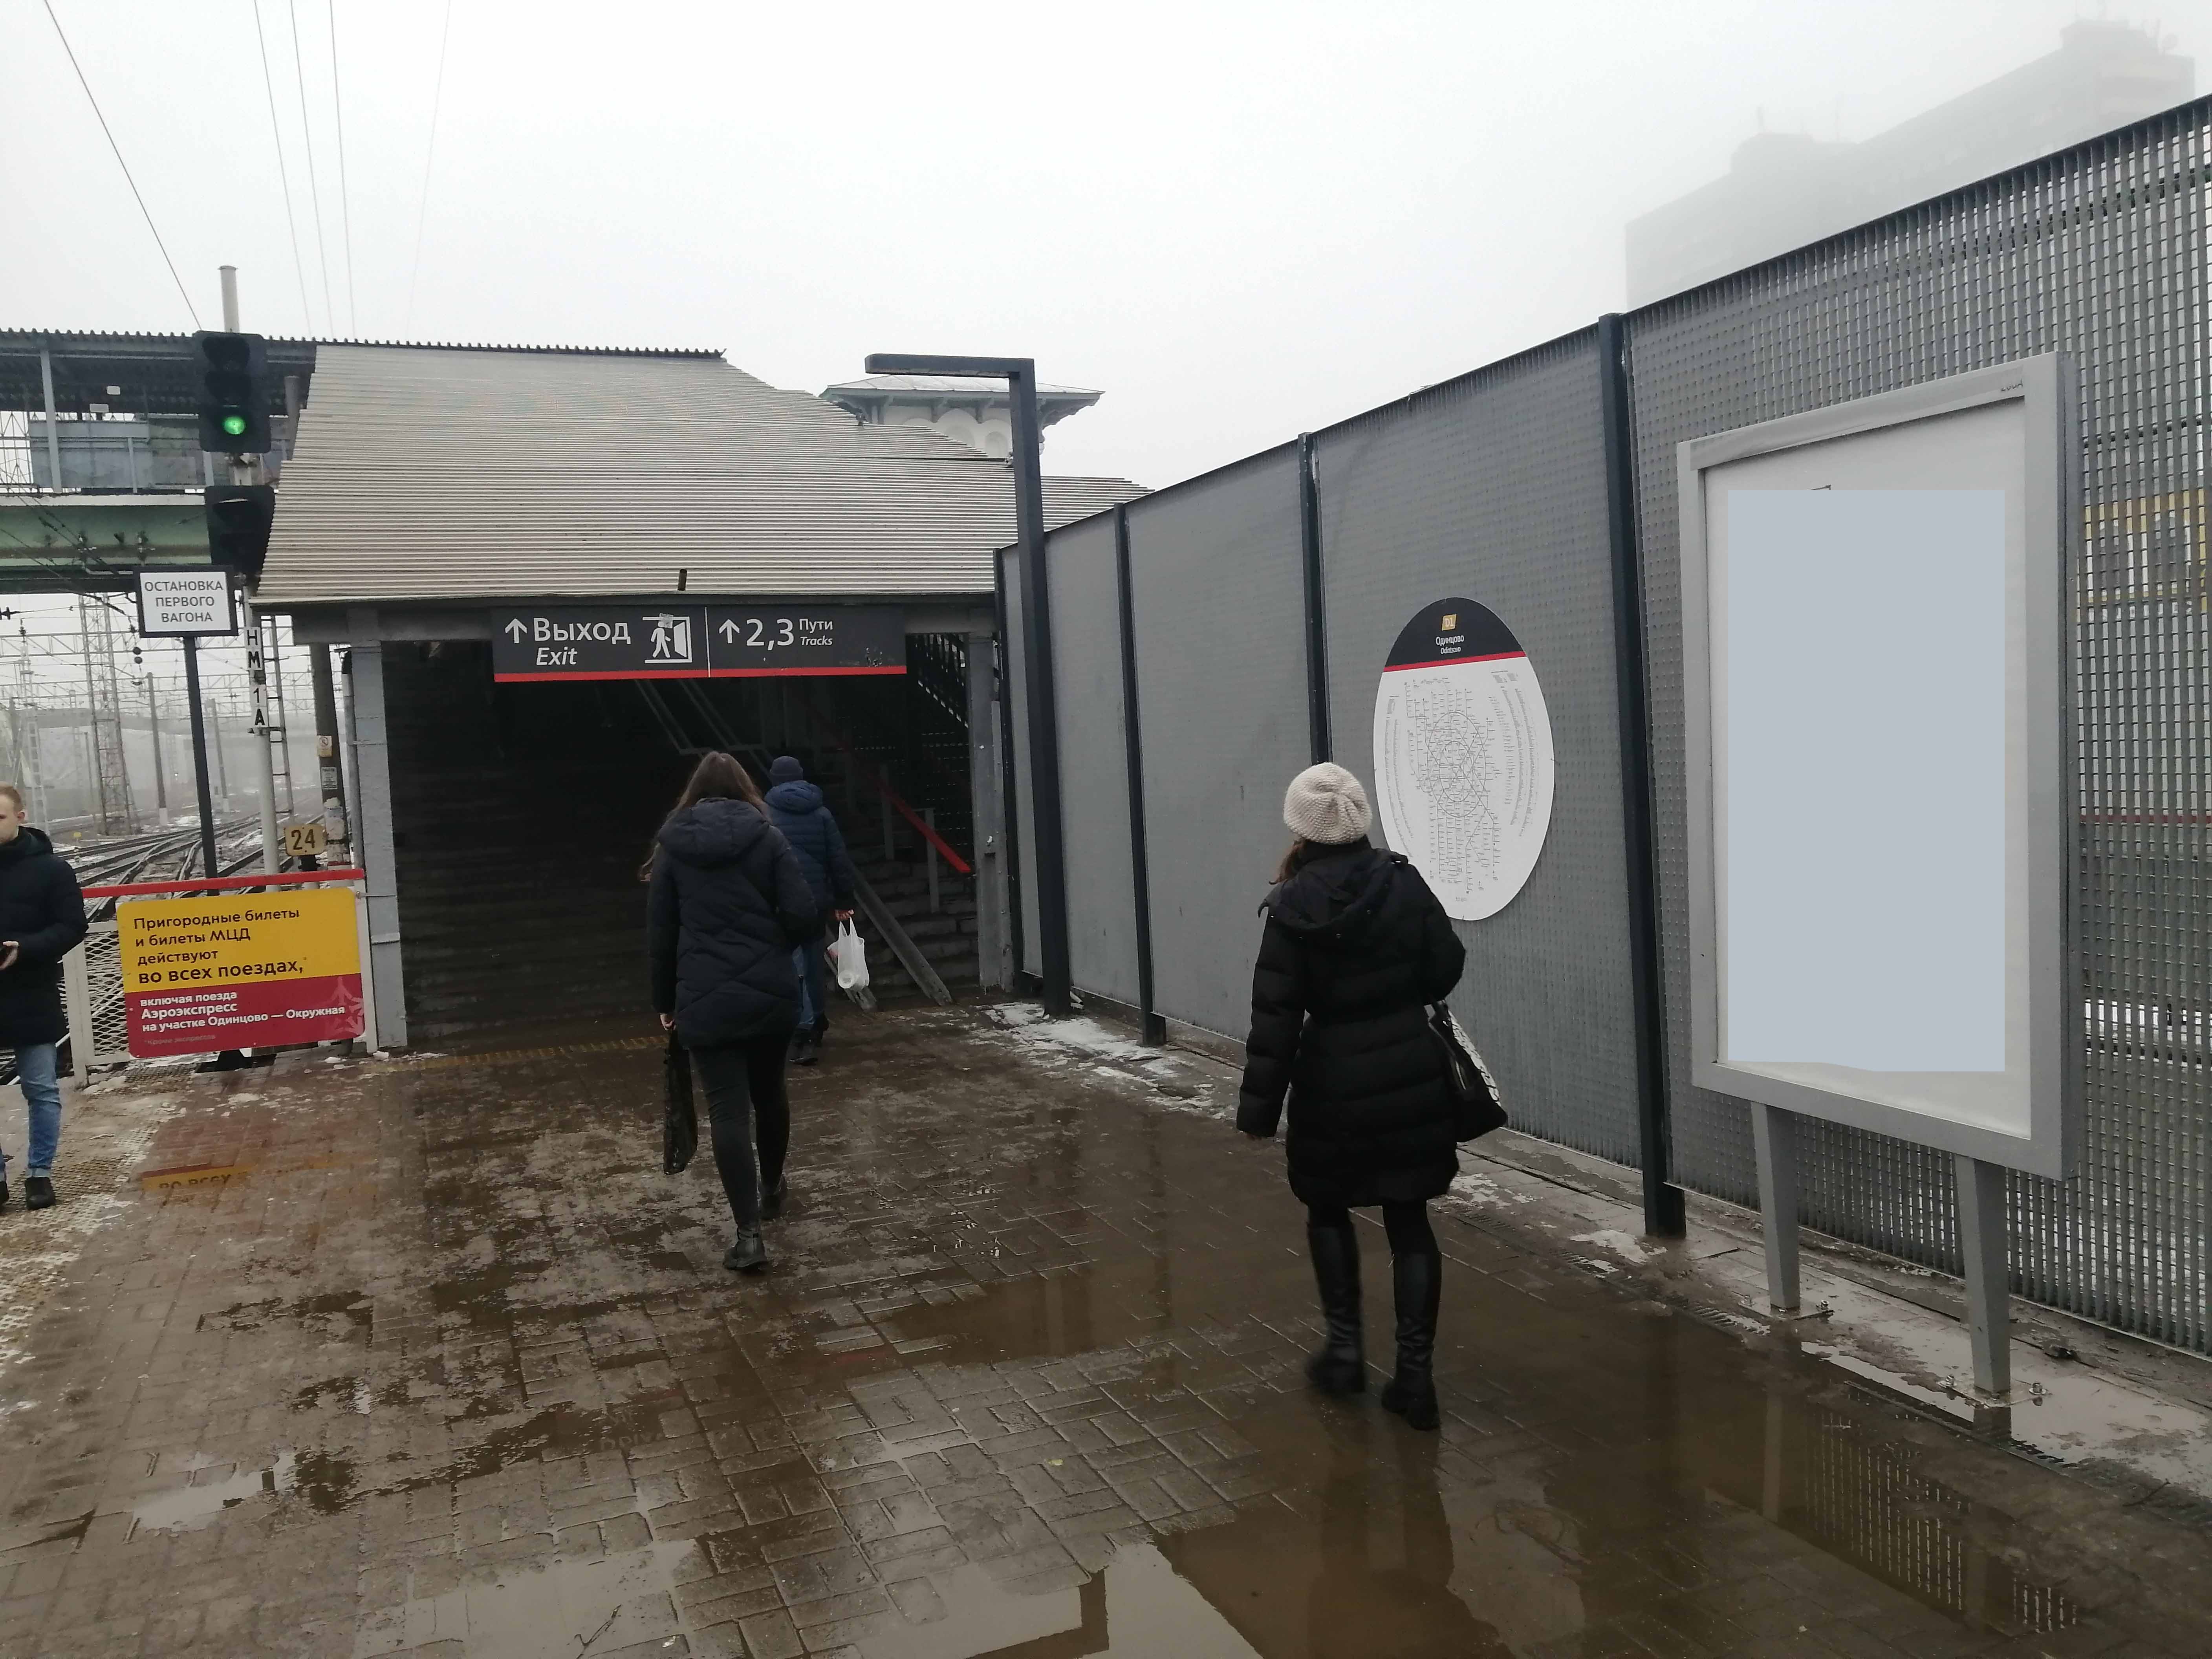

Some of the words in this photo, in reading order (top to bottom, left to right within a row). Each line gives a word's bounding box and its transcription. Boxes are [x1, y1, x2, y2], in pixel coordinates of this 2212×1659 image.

[145, 581, 223, 591] ОСТАНОВКА
[156, 596, 215, 607] ПЕРВОГО
[161, 612, 213, 623] ВАГОНА
[1445, 617, 1454, 627] D1
[533, 617, 631, 645] Выход
[746, 618, 795, 651] 2,3
[799, 618, 833, 634] Пути
[800, 635, 833, 646] Tracks
[1436, 635, 1465, 646] Одинцово
[536, 646, 578, 665] Exit
[291, 828, 316, 850] 24
[134, 913, 241, 931] Пригородные
[245, 909, 300, 921] билеты
[136, 938, 145, 947] и
[149, 933, 205, 946] билеты
[210, 928, 251, 941] МЦД
[138, 950, 218, 966] действуют
[139, 972, 162, 984] во
[168, 967, 213, 982] всех
[140, 995, 192, 1007] включая
[195, 991, 237, 1002] поезда
[141, 1003, 238, 1020] Аэроэкспресс
[142, 1023, 157, 1032] на
[159, 1019, 206, 1033] участке
[207, 1013, 269, 1027] Одинцово
[286, 1006, 345, 1019] Окружная
